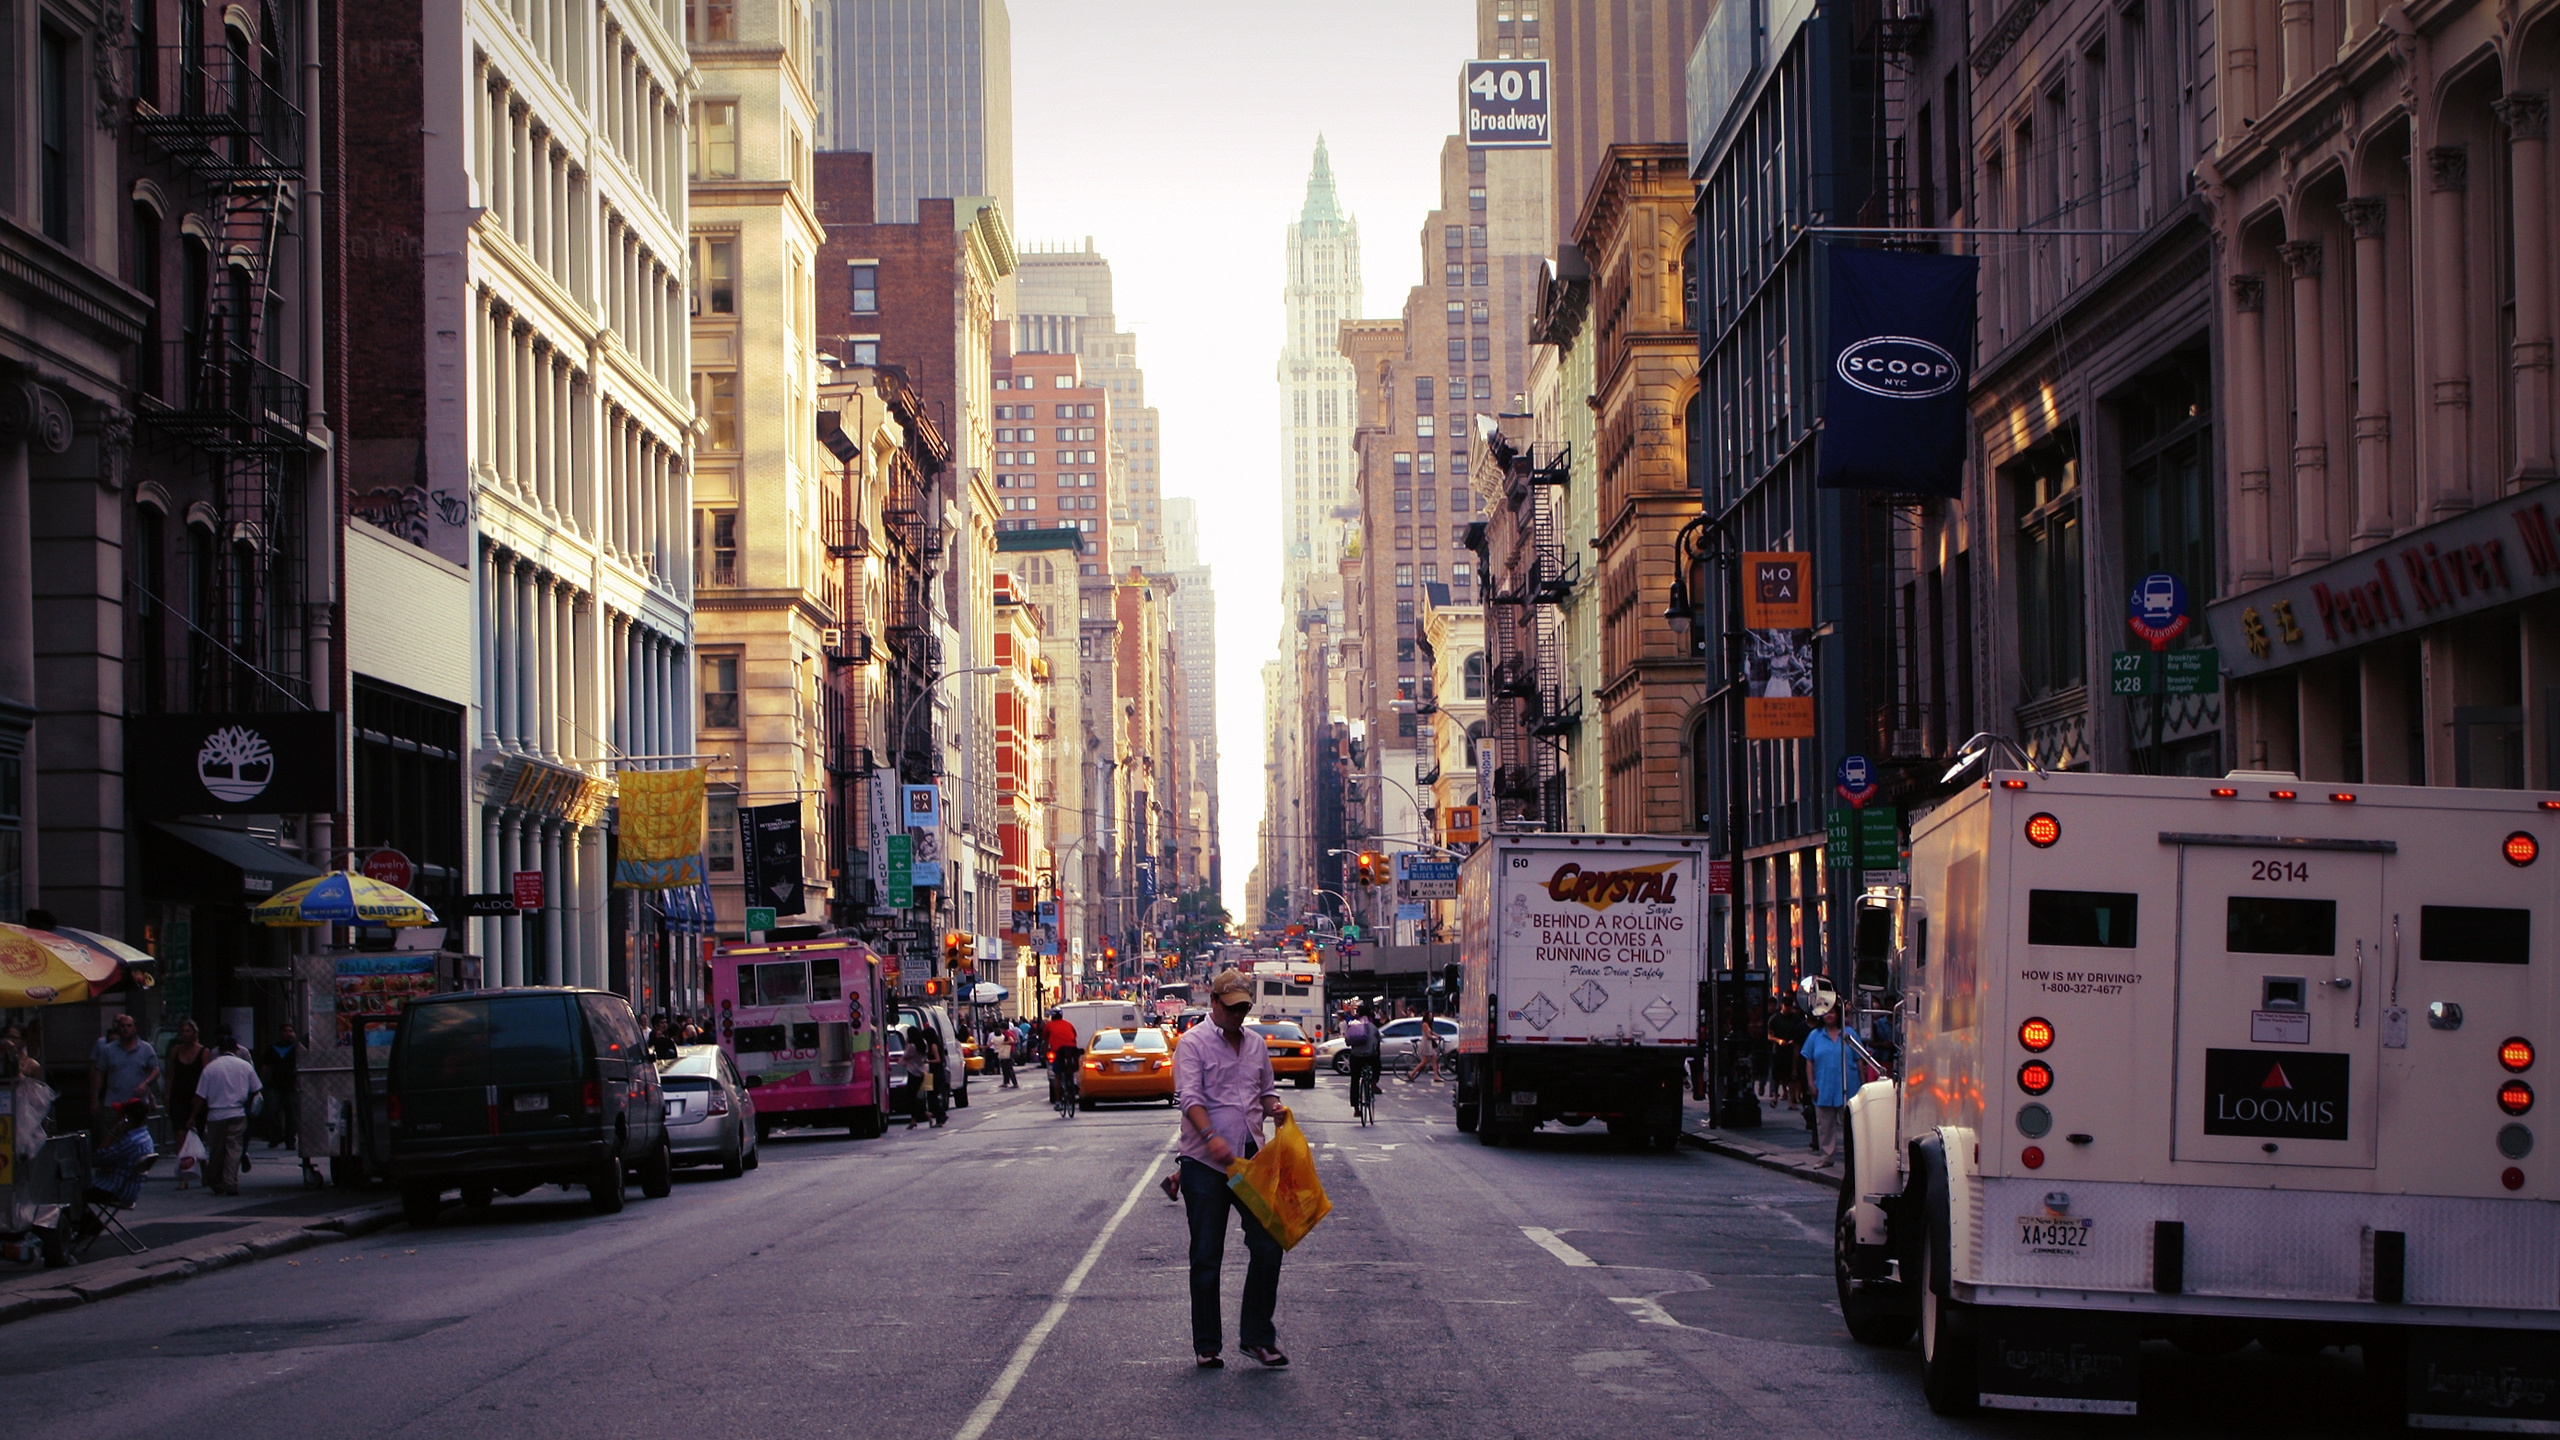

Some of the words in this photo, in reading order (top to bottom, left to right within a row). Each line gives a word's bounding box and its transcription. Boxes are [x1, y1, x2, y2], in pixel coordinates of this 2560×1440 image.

[1470, 70, 1540, 101] 401
[1471, 107, 1546, 136] Broadway
[1850, 357, 1948, 378] SCOOP
[1884, 378, 1908, 387] NYC
[2309, 557, 2404, 641] Pearl
[2400, 541, 2510, 612] River
[2511, 502, 2560, 577] M
[2133, 619, 2143, 632] NO
[2144, 617, 2183, 639] STANDING
[2114, 655, 2141, 671] x27
[2167, 662, 2179, 671] Bay
[2183, 662, 2201, 670] Ridge
[2114, 677, 2141, 692] x28
[1828, 826, 1848, 837] x10
[741, 812, 753, 867] PREPARING
[1829, 841, 1848, 852] x12
[369, 860, 406, 870] Jewelry
[1512, 858, 1529, 868] 60
[1829, 855, 1854, 867] x17C
[2252, 860, 2309, 882] 2614
[358, 905, 418, 917] SABRETT
[473, 900, 513, 910] ALDO
[1645, 903, 1673, 918] Says
[866, 919, 884, 928] GRAND
[1527, 913, 1590, 929] "BEHIND
[1595, 915, 1607, 929] A
[1612, 914, 1684, 931] ROLLING
[1031, 938, 1044, 946] 30
[1542, 931, 1581, 946] BALL
[1585, 931, 1646, 947] COMES
[1651, 932, 1663, 946] A
[1536, 947, 1611, 963] RUNNING
[1617, 949, 1672, 964] CHILD"
[1569, 965, 1600, 977] Please
[1603, 966, 1630, 977] Drive
[1632, 967, 1665, 980] Safely
[2022, 970, 2050, 981] HOW
[2053, 971, 2064, 981] IS
[2067, 971, 2085, 982] MY
[2088, 972, 2142, 984] DRIVING?
[2041, 983, 2122, 995] 1-800-327-4677
[772, 1047, 818, 1062] YOGO
[2033, 1247, 2075, 1255] COMMERCIAL
